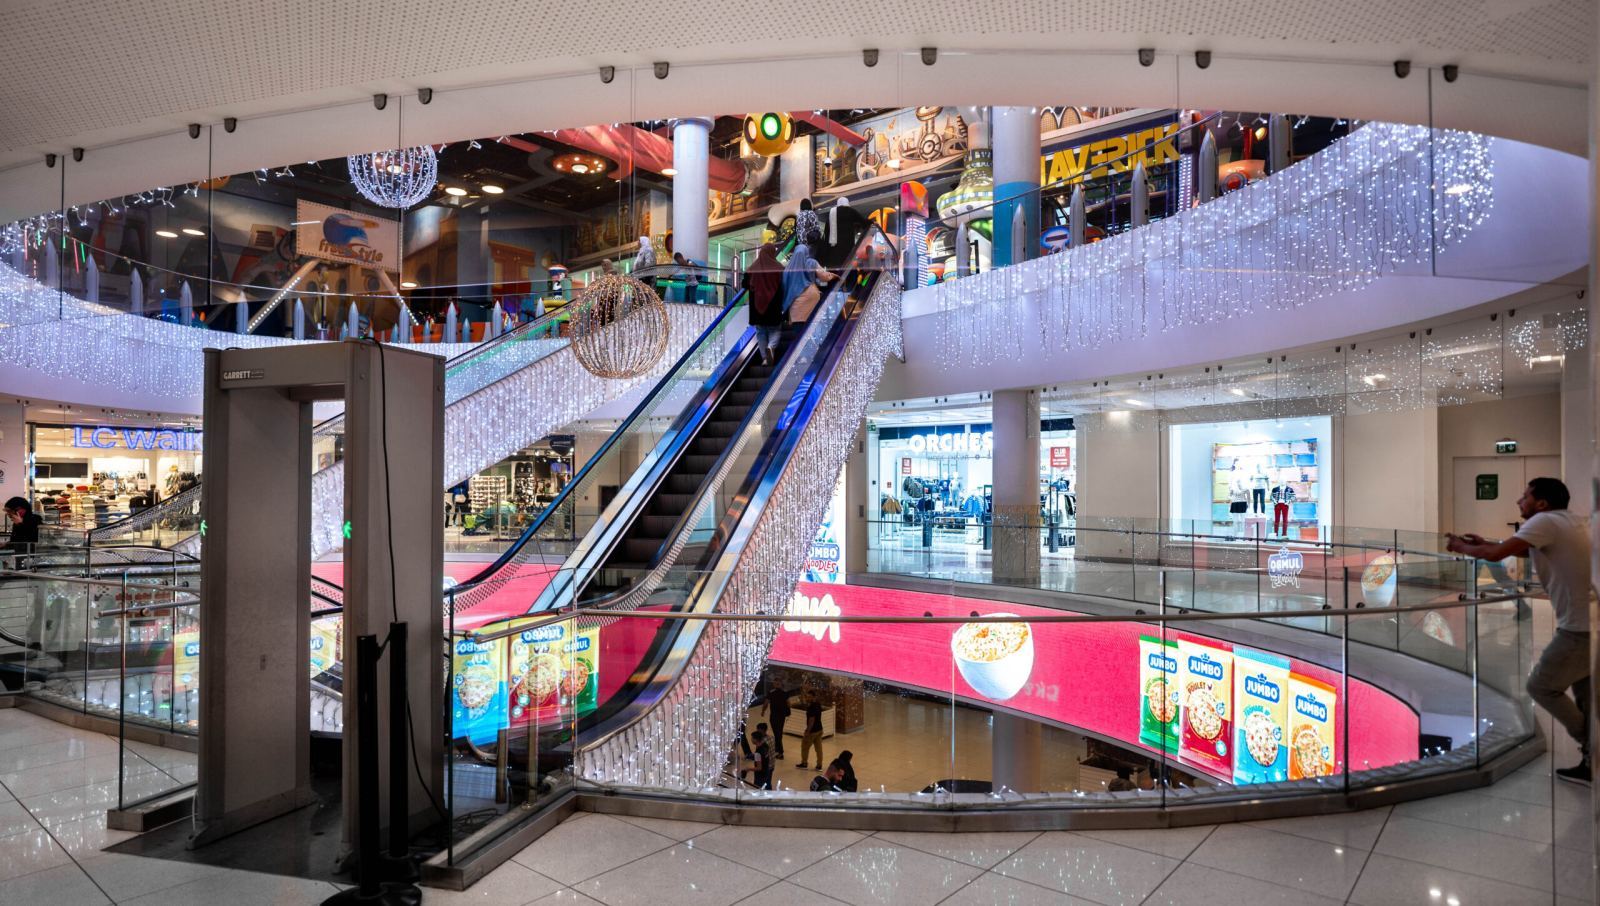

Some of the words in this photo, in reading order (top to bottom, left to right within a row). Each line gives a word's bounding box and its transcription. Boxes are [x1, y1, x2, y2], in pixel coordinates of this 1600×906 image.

[1041, 122, 1180, 189] AVERICK
[223, 370, 251, 380] GARRETT
[74, 426, 117, 449] LC
[909, 432, 993, 452] ORCHES
[808, 545, 838, 560] UMBO
[1190, 660, 1221, 678] JUMBO
[1246, 679, 1278, 700] JUMBO
[1296, 697, 1326, 718] JUMBO
